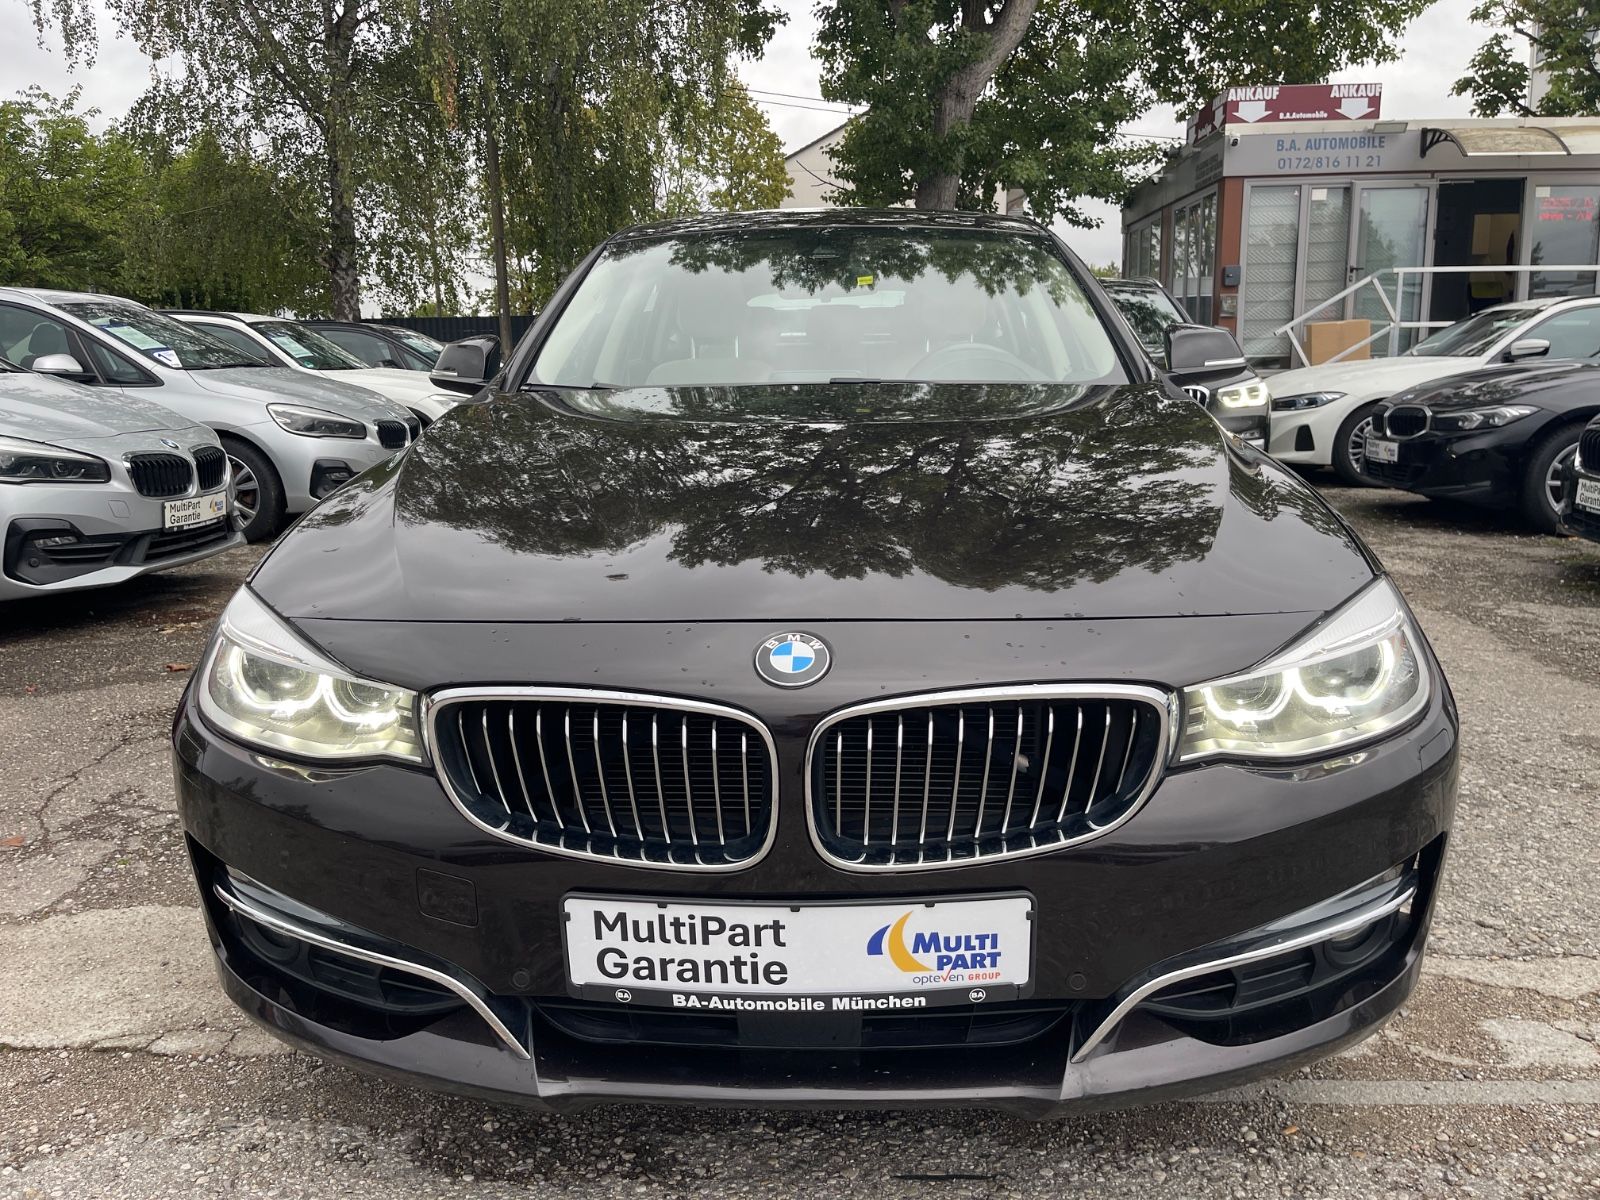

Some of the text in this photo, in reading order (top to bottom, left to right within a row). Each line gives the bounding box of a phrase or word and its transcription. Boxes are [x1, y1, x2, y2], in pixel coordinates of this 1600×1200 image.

[1227, 86, 1280, 102] ANKAUF
[1330, 83, 1382, 98] ANKAUF
[1276, 136, 1386, 152] B.A. AUTOMOBILE
[1277, 155, 1381, 170] 0172/816 11 21
[170, 501, 201, 513] MultiPart
[170, 511, 200, 524] Garantie
[764, 634, 824, 650] BMW
[593, 910, 786, 947] MultiPart
[912, 932, 998, 954] MULTI
[596, 947, 788, 986] Garantie
[936, 952, 1002, 971] PART
[912, 971, 1001, 986] opteven GROUP
[672, 993, 926, 1011] BA-Automobile München
